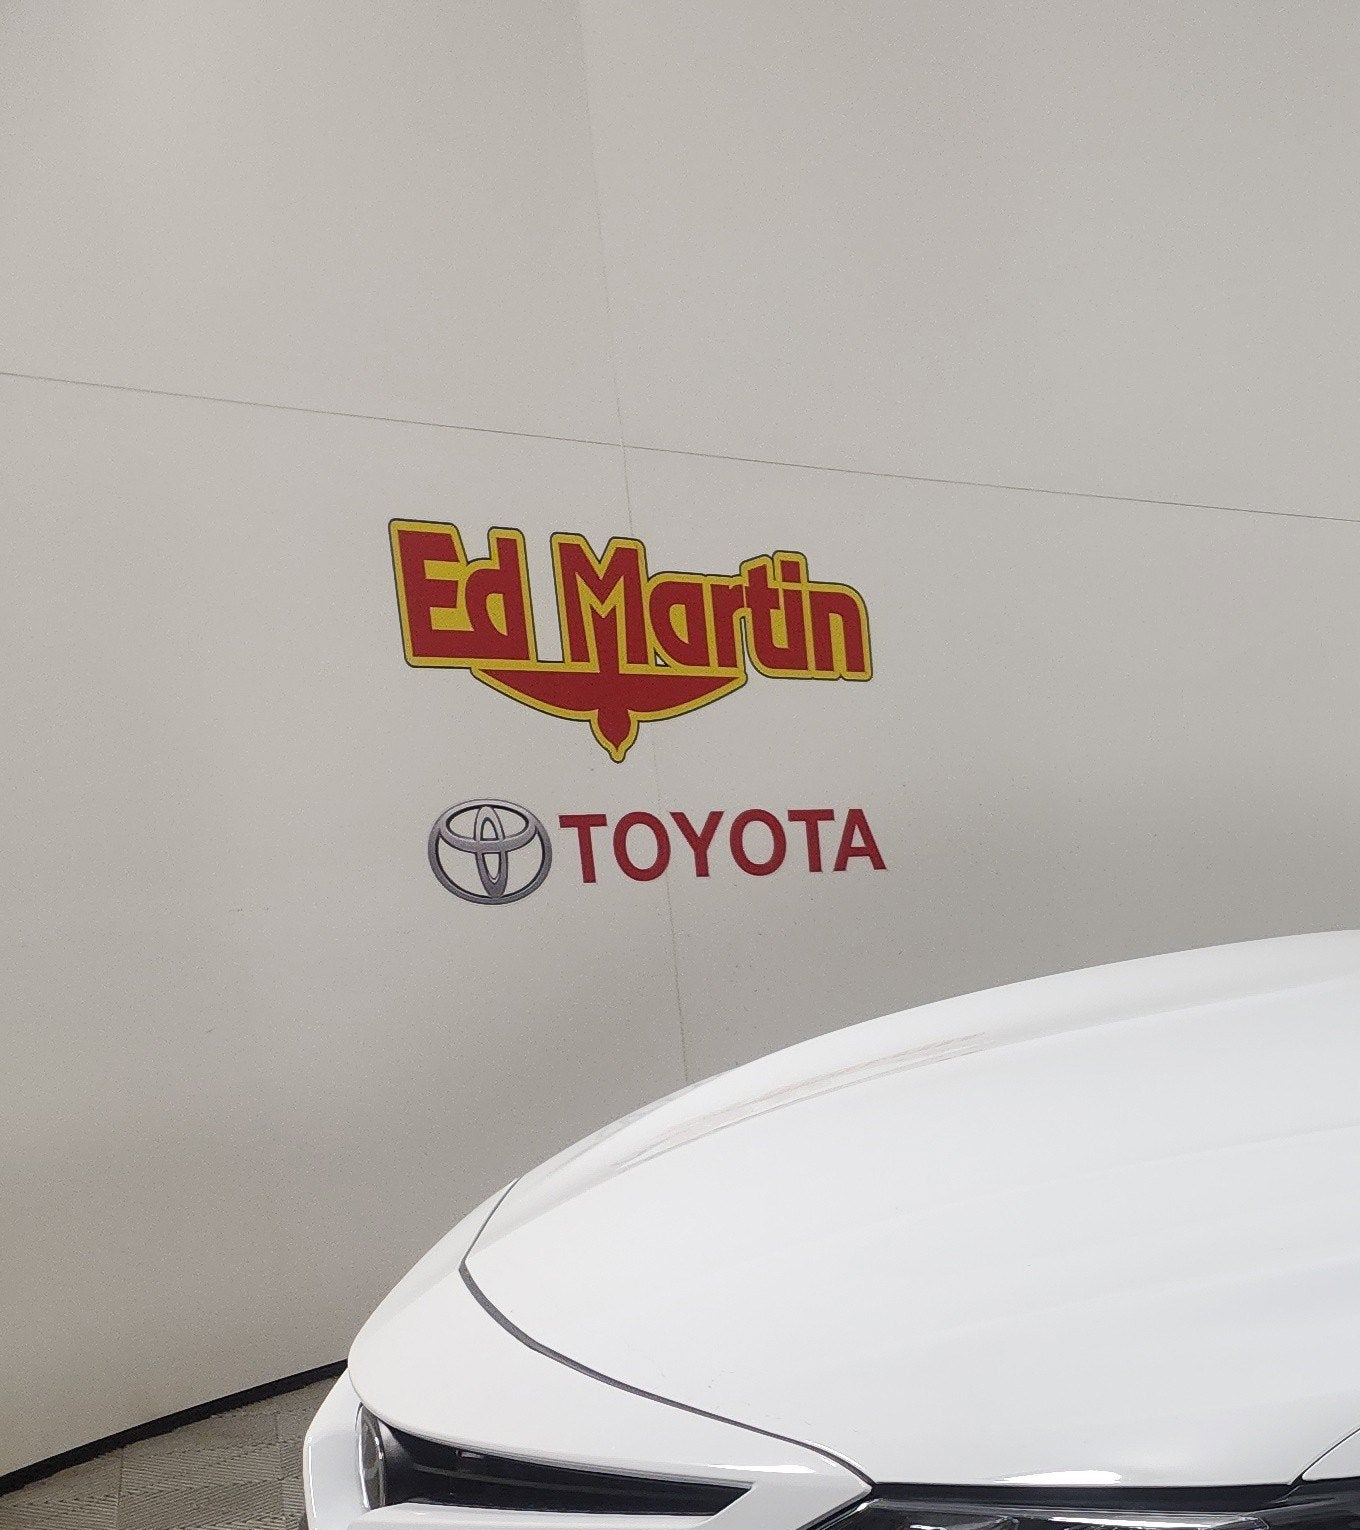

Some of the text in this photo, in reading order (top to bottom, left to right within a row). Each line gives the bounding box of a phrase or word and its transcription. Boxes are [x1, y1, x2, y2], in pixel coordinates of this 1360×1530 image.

[389, 519, 873, 681] Ed Martin
[559, 808, 887, 883] TOYOTA
